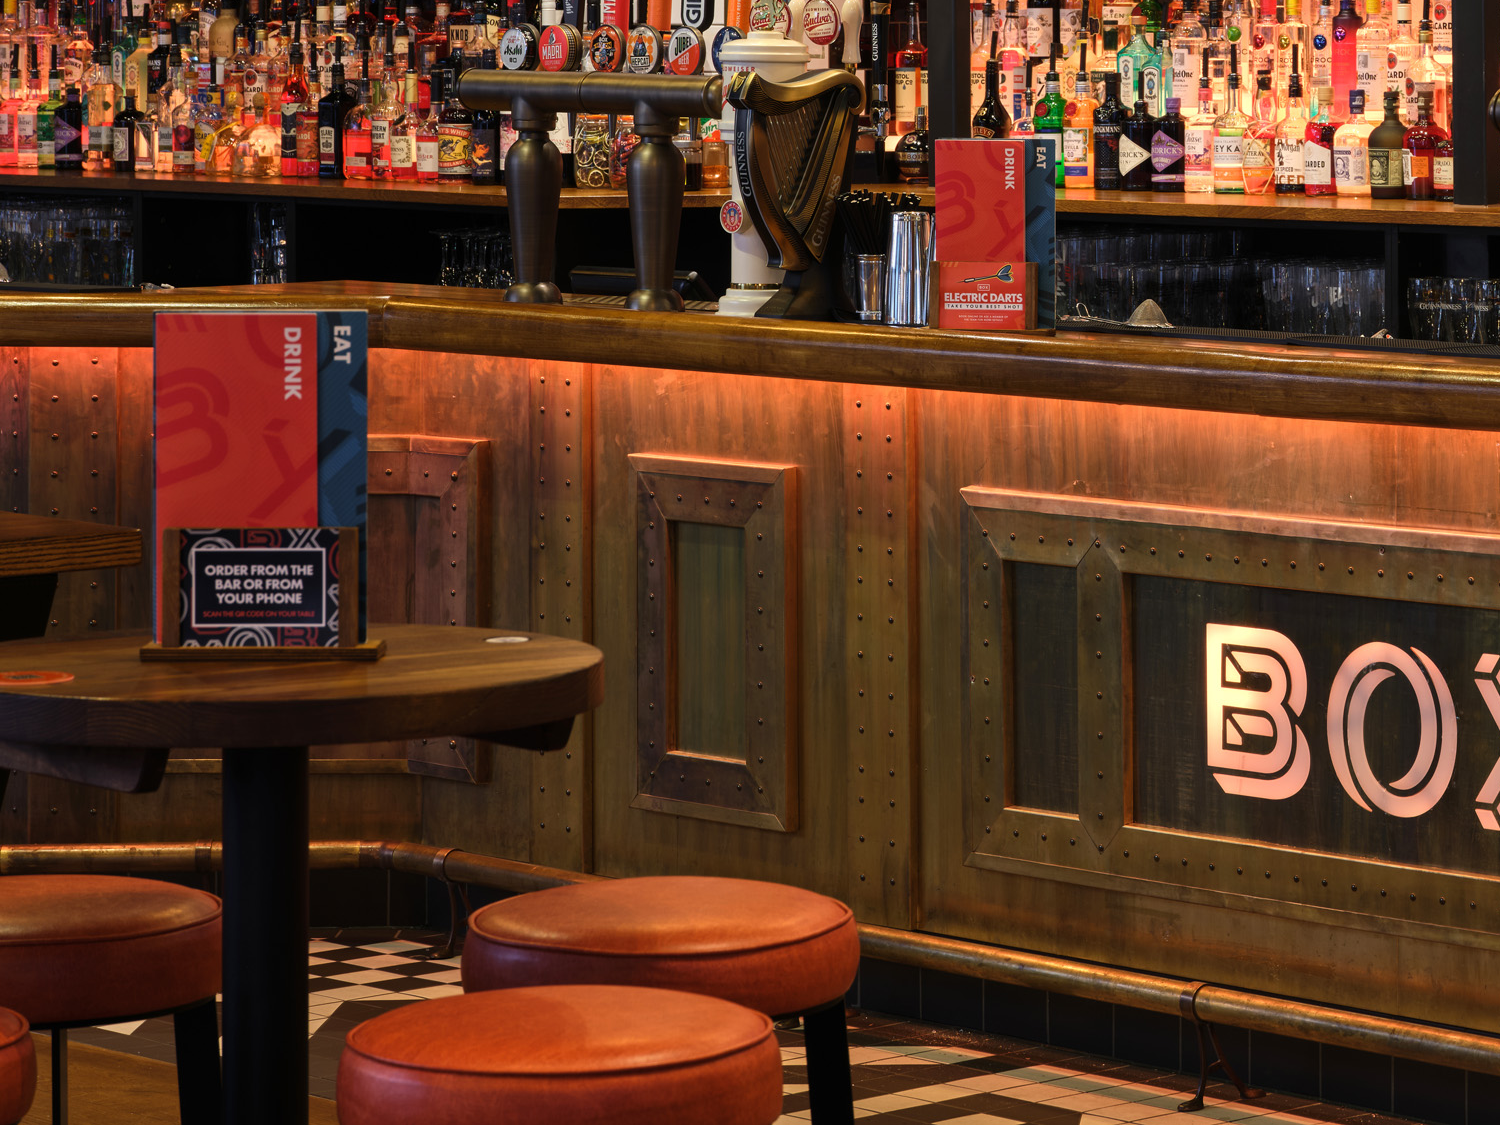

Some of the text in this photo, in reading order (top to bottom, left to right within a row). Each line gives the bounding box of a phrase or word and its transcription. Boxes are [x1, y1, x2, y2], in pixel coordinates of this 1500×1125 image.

[804, 13, 834, 28] Budvar
[450, 28, 469, 41] KNOB
[504, 45, 522, 55] Asahi
[674, 37, 692, 56] JUBEL
[678, 52, 690, 65] BEER
[1386, 70, 1406, 79] CARDÍ
[320, 129, 333, 137] SLANE
[450, 129, 468, 137] WHIP
[736, 131, 752, 197] GUINNESS
[1036, 146, 1046, 169] EAT
[1004, 148, 1015, 190] DRINK
[811, 175, 842, 247] GUINNESS
[944, 293, 1023, 303] ELECTRIC DARTS
[333, 325, 352, 365] EAT
[283, 326, 302, 401] DRINK
[204, 564, 314, 576] ORDER FROM THE
[214, 579, 304, 591] BAR OR FROM
[216, 593, 302, 605] YOUR PHONE
